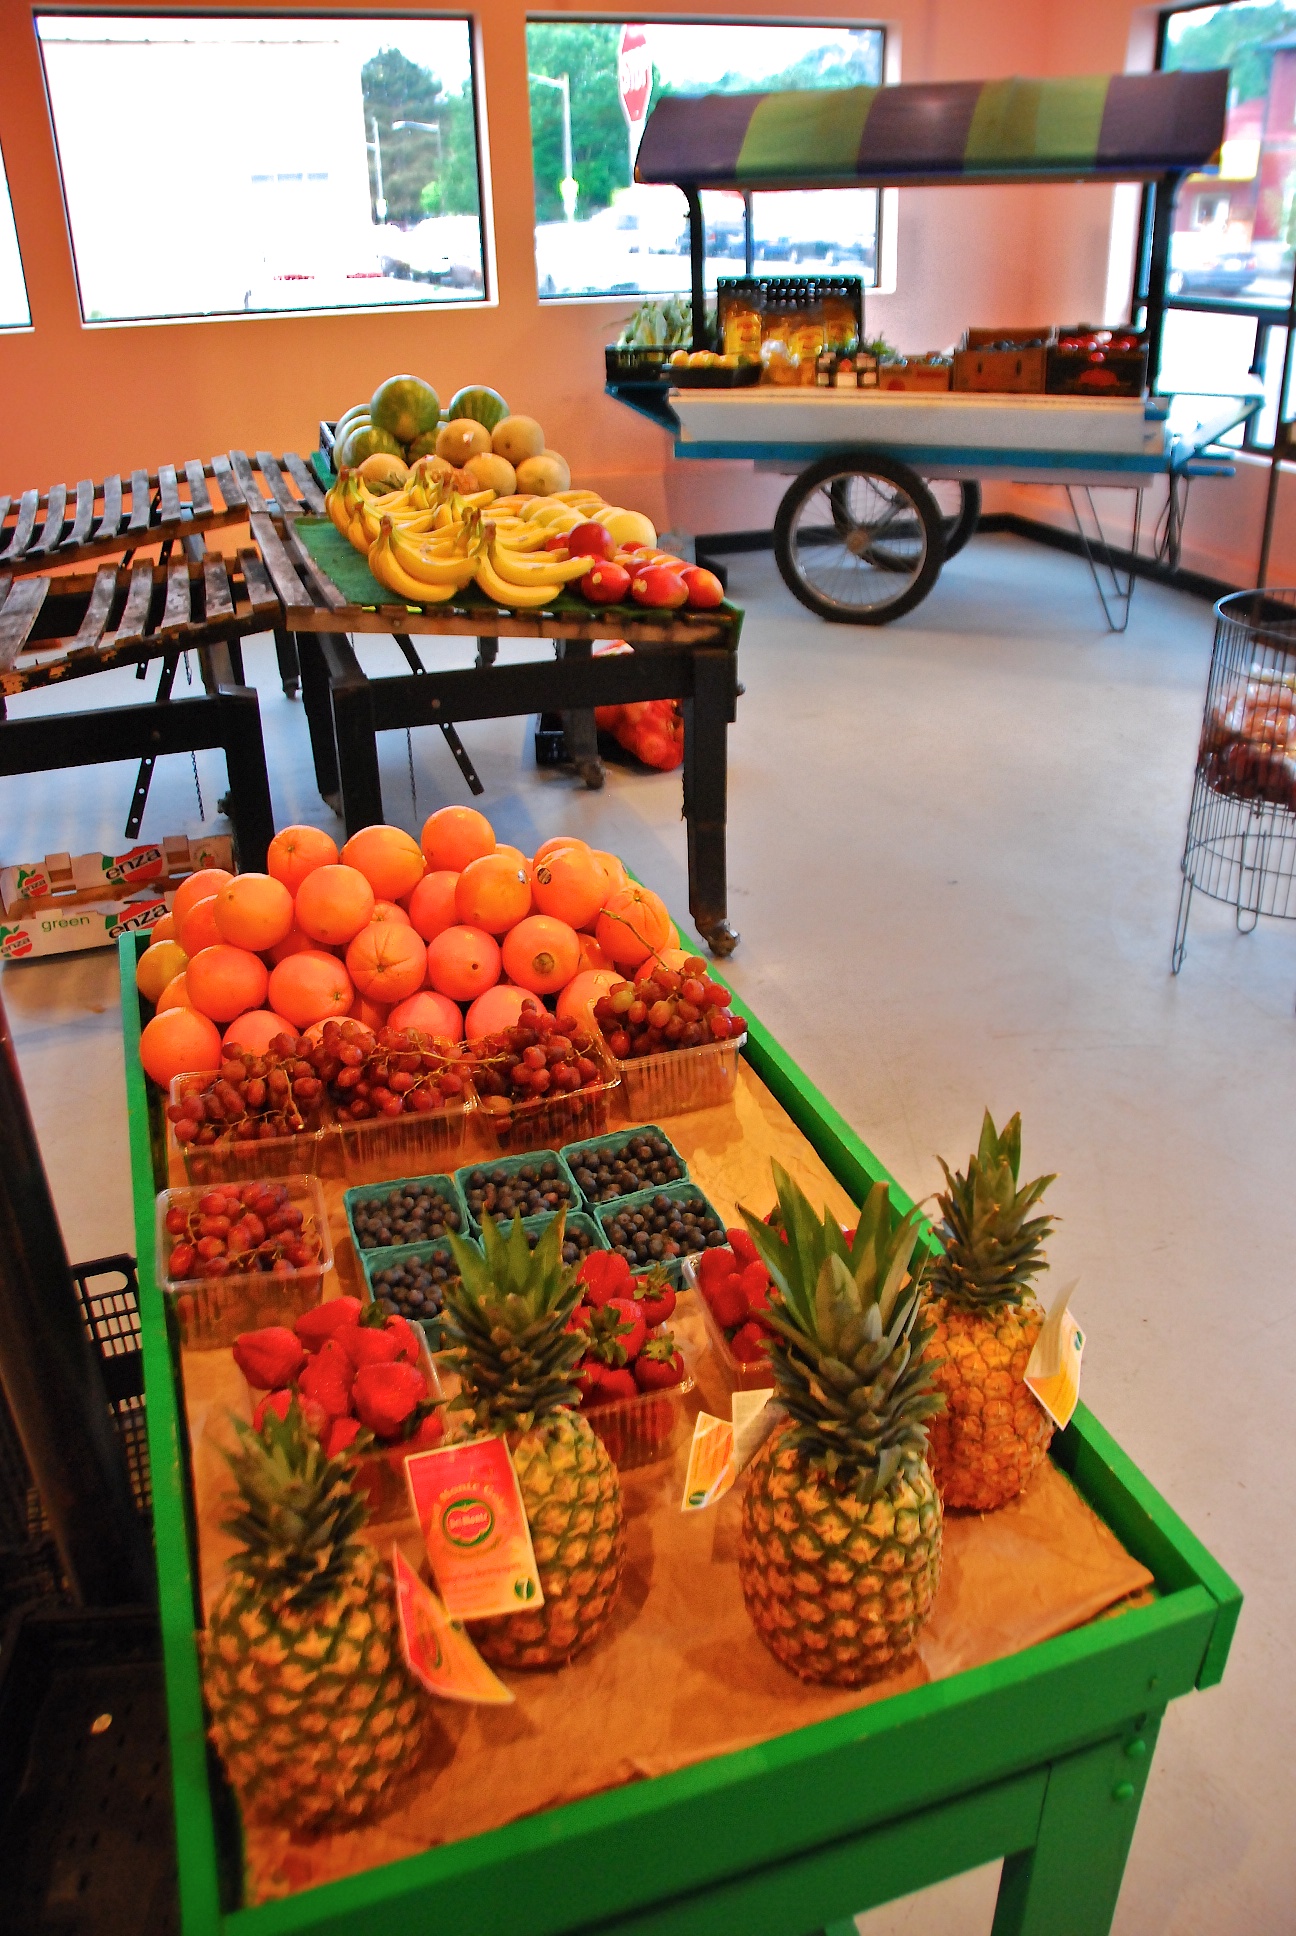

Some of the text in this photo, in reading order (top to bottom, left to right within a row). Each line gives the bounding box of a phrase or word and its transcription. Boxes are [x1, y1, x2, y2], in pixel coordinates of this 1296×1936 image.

[106, 847, 161, 880] enza
[21, 879, 46, 894] enza
[41, 915, 90, 933] green
[109, 902, 169, 939] enza
[1, 937, 31, 953] enza
